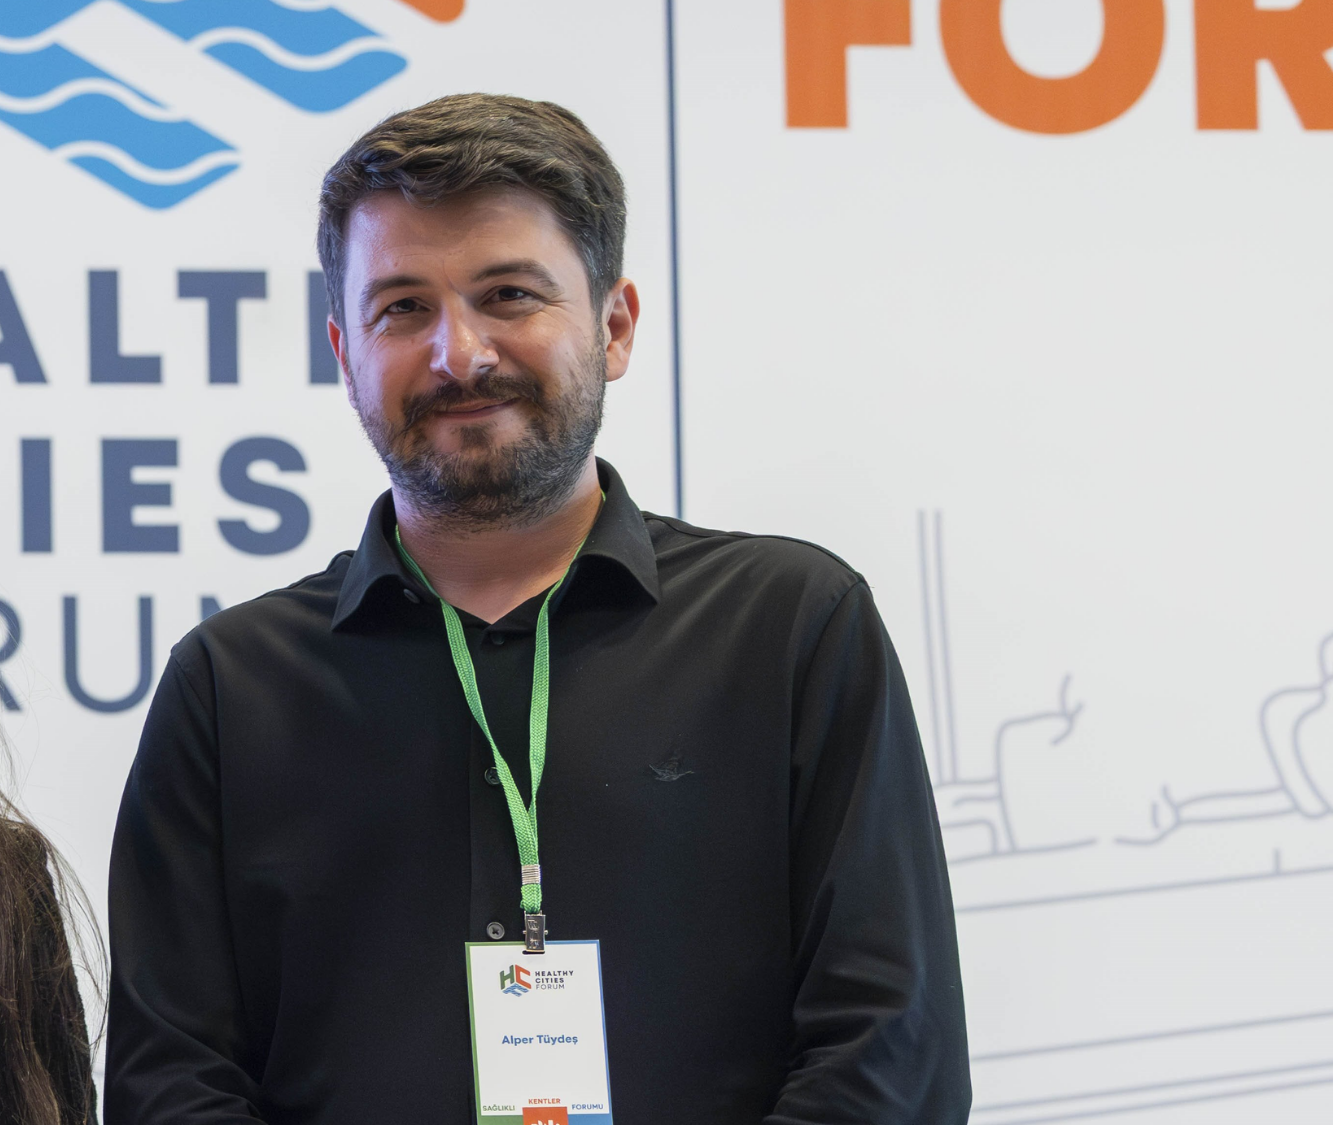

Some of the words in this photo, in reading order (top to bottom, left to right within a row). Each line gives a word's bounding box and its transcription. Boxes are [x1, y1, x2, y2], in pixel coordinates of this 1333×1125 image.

[501, 1034, 534, 1046] Alper
[536, 1034, 578, 1046] Tüydeş
[482, 1104, 516, 1112] SAĞLIKLI
